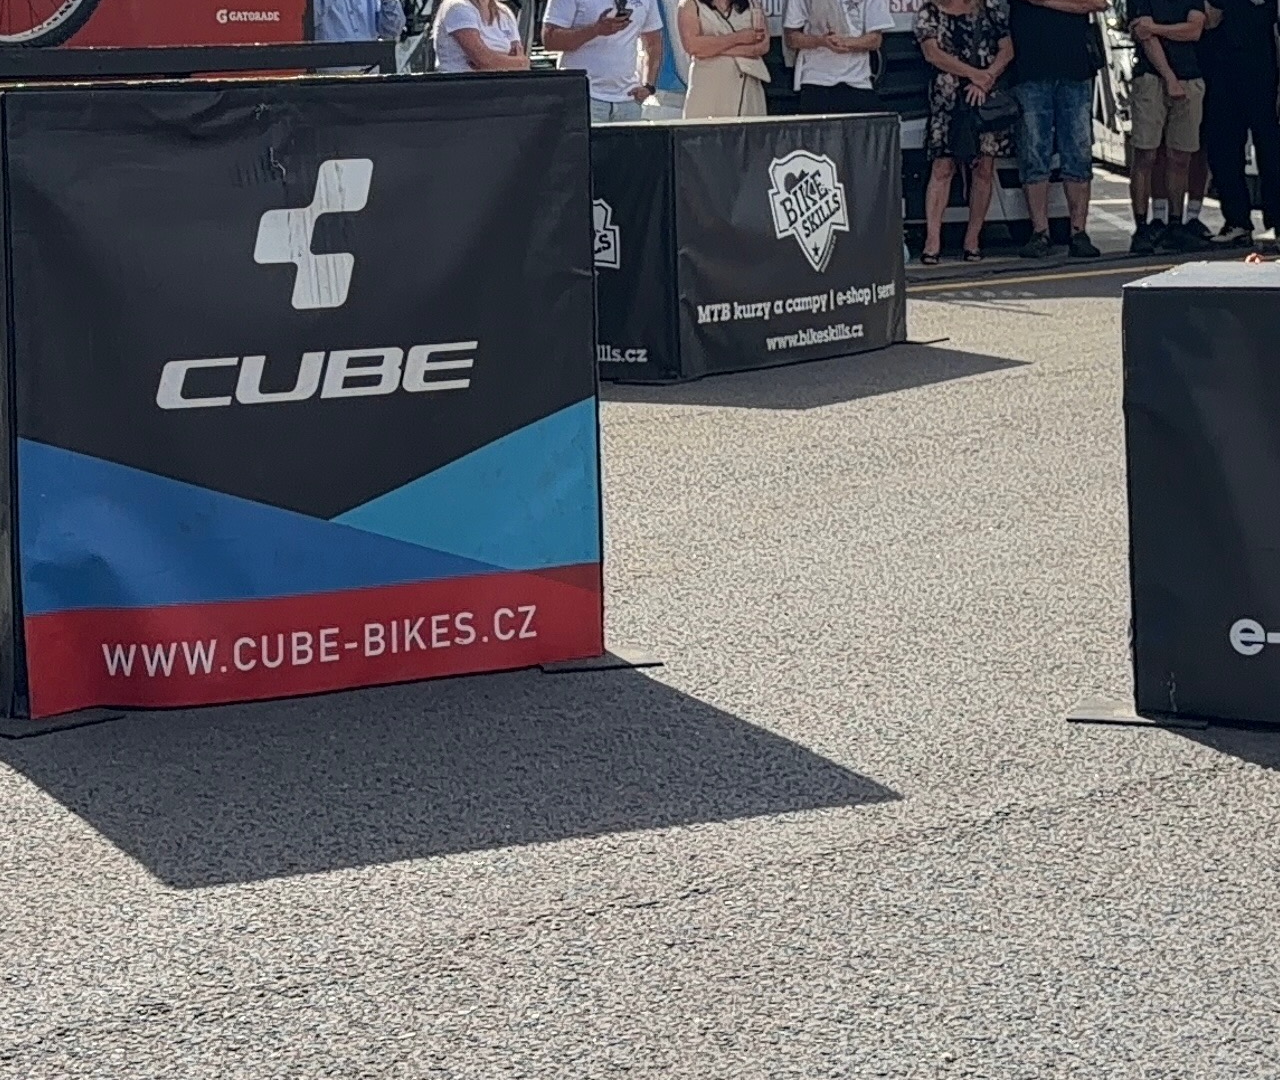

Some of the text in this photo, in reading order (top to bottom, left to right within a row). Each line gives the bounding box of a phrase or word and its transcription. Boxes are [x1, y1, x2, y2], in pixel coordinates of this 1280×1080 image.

[229, 11, 280, 22] GATORADE
[780, 169, 829, 227] BIKE
[802, 192, 841, 238] SKILLS
[697, 304, 731, 323] MTB
[733, 301, 771, 319] kurzy
[773, 300, 783, 314] a
[785, 294, 829, 313] campy
[836, 286, 871, 305] e-shop
[766, 323, 864, 351] www.bikeskills.cz
[156, 341, 478, 409] CUBE
[102, 605, 538, 678] WWW.CUBE-BIKES.CZ
